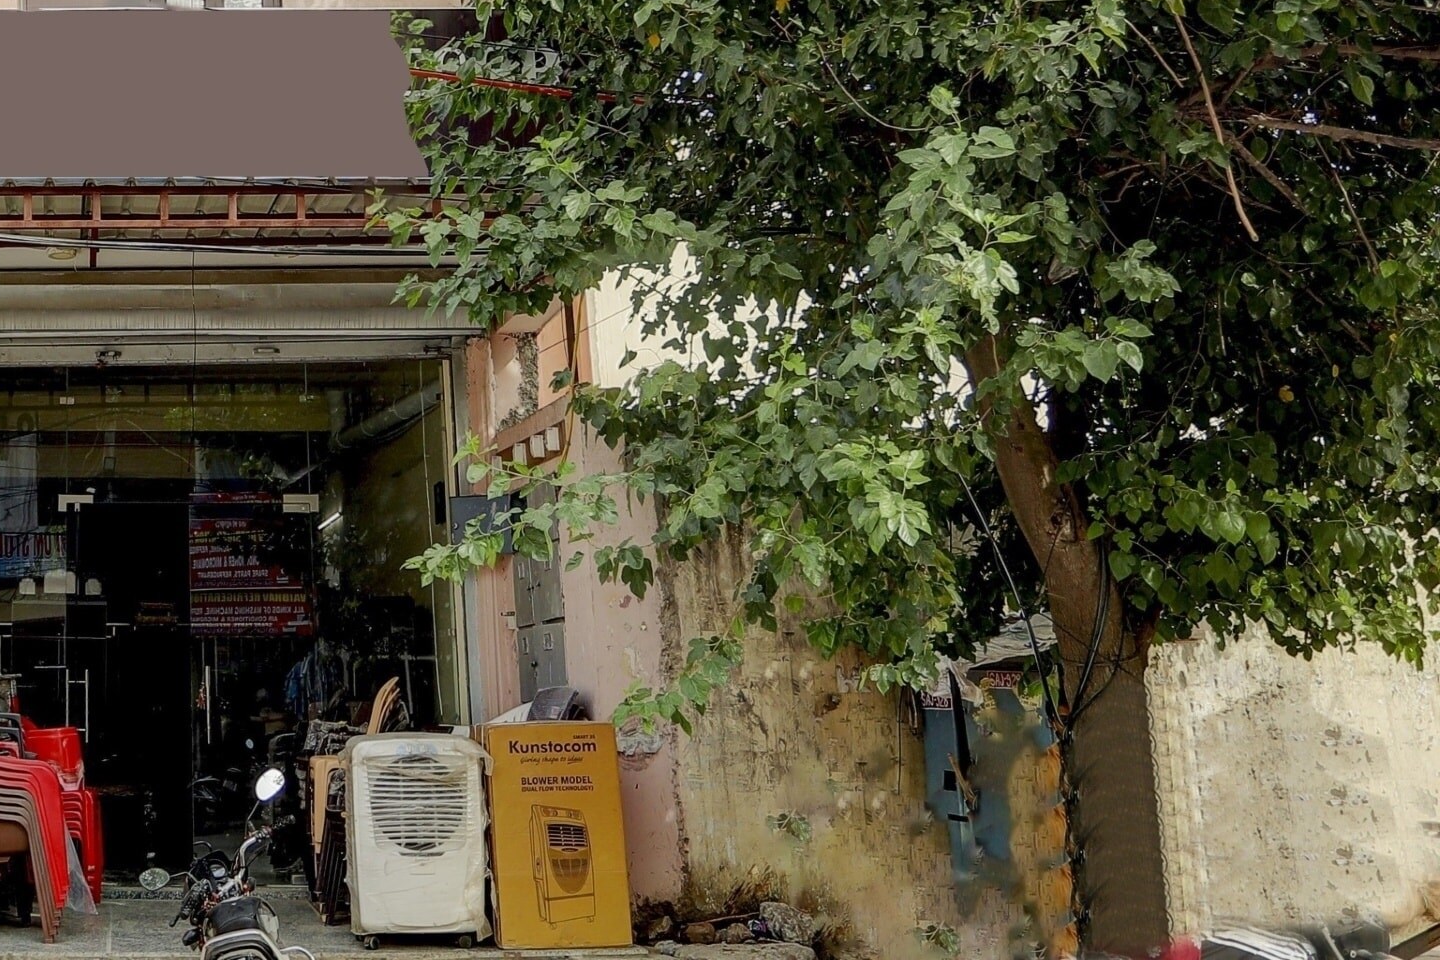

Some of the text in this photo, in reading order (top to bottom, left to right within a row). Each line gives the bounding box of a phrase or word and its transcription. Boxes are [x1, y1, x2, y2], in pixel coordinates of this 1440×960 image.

[509, 741, 597, 754] Kunstocom
[521, 776, 592, 785] BLOWER MODEL
